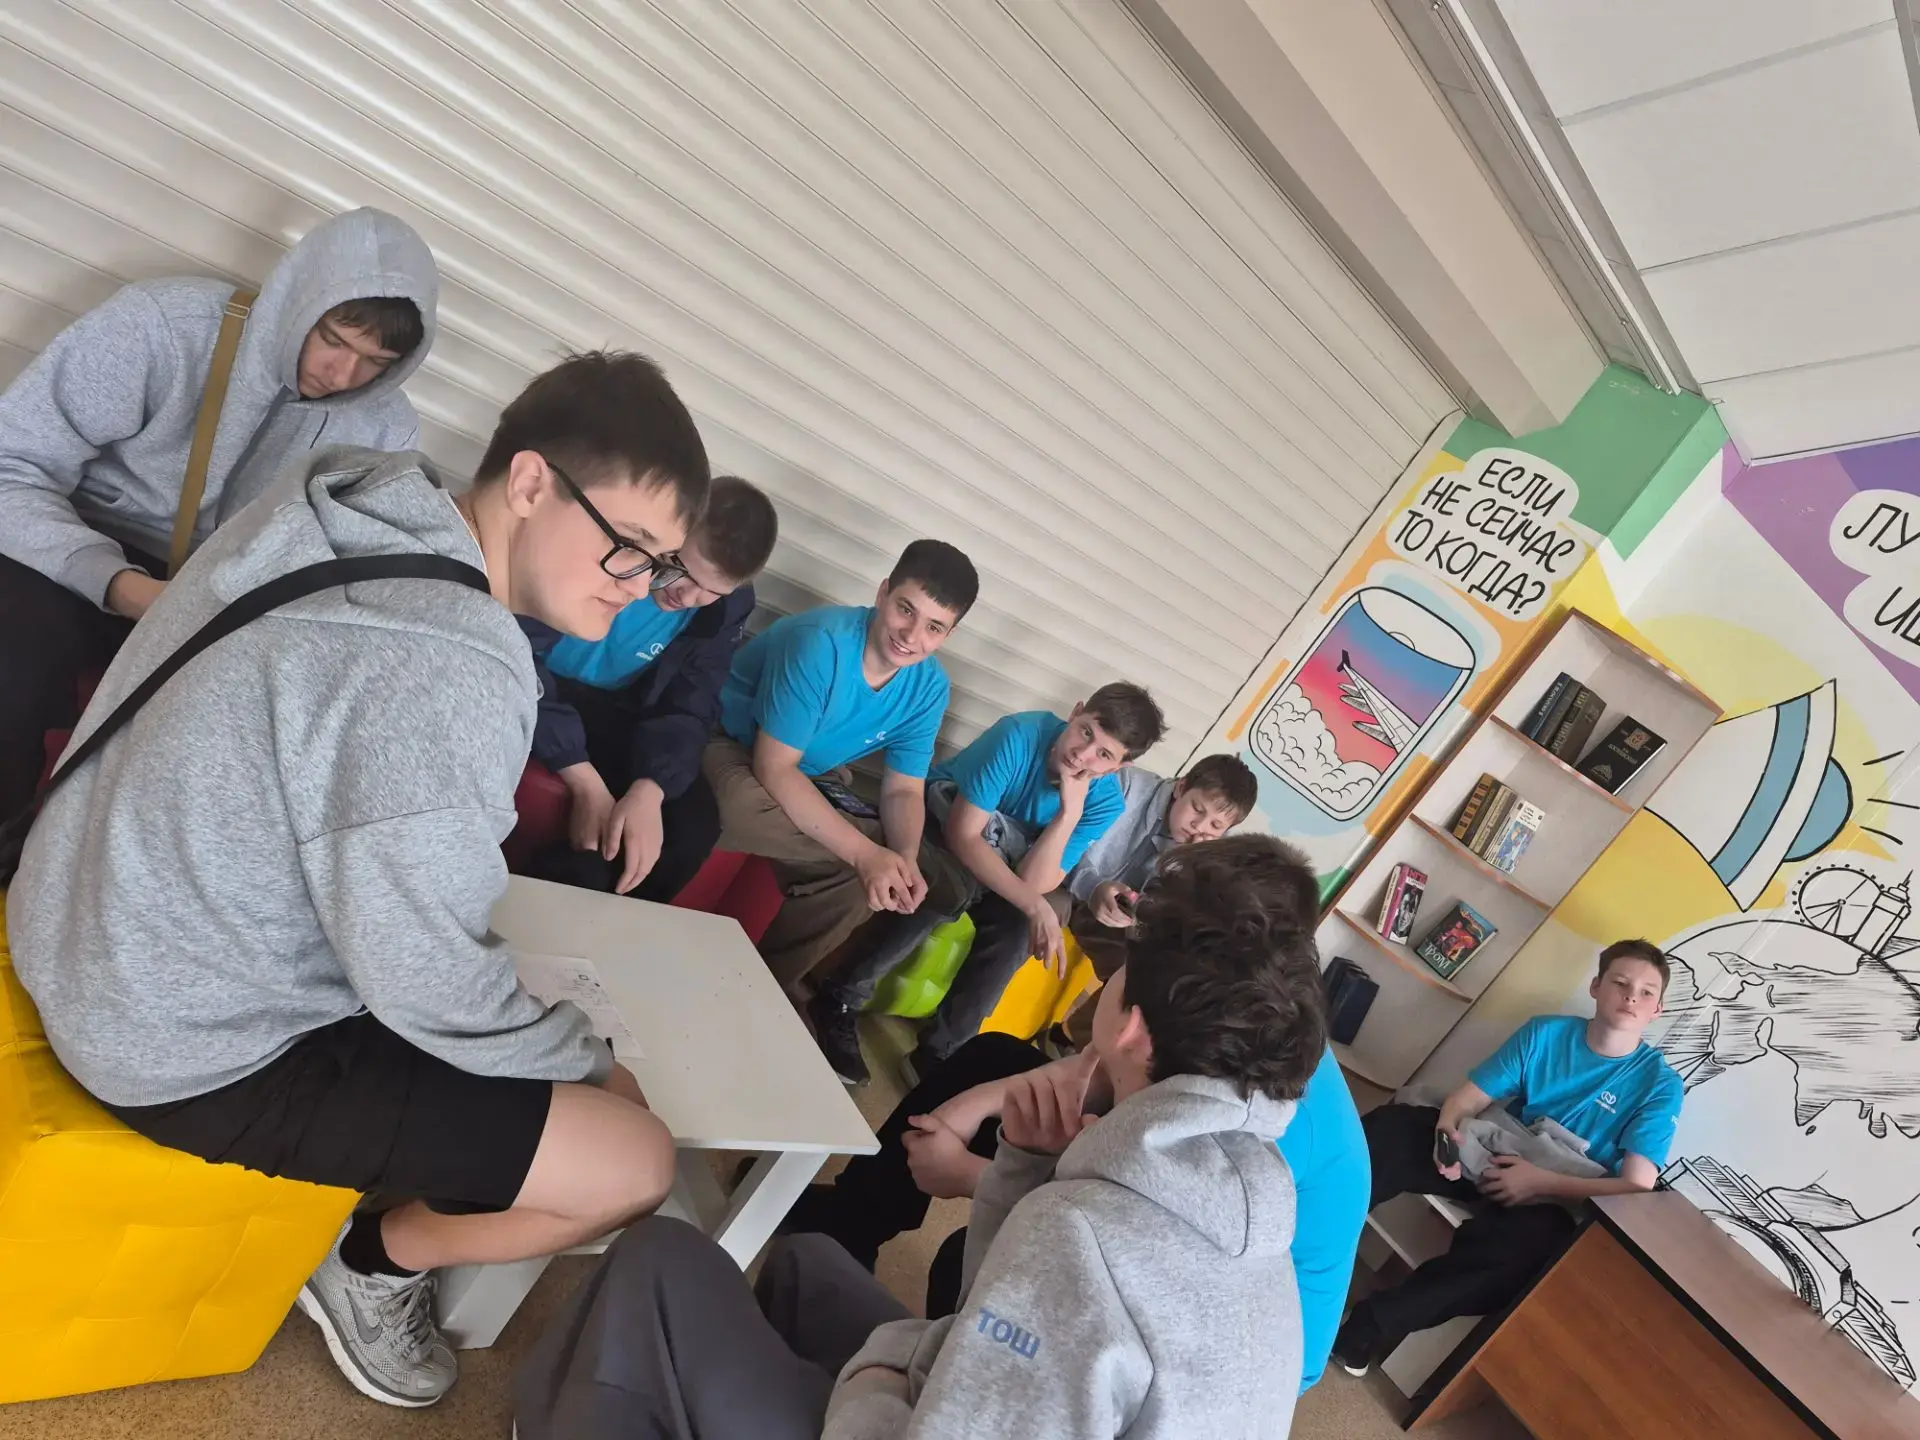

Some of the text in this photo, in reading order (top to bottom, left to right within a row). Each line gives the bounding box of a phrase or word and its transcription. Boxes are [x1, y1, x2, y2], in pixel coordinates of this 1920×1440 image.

[1420, 476, 1576, 573] НЕ СЕЙЧАС
[1478, 457, 1566, 517] ЕСЛИ
[1394, 509, 1546, 615] ТО КОГДА?
[977, 1307, 1041, 1360] ТОШ
